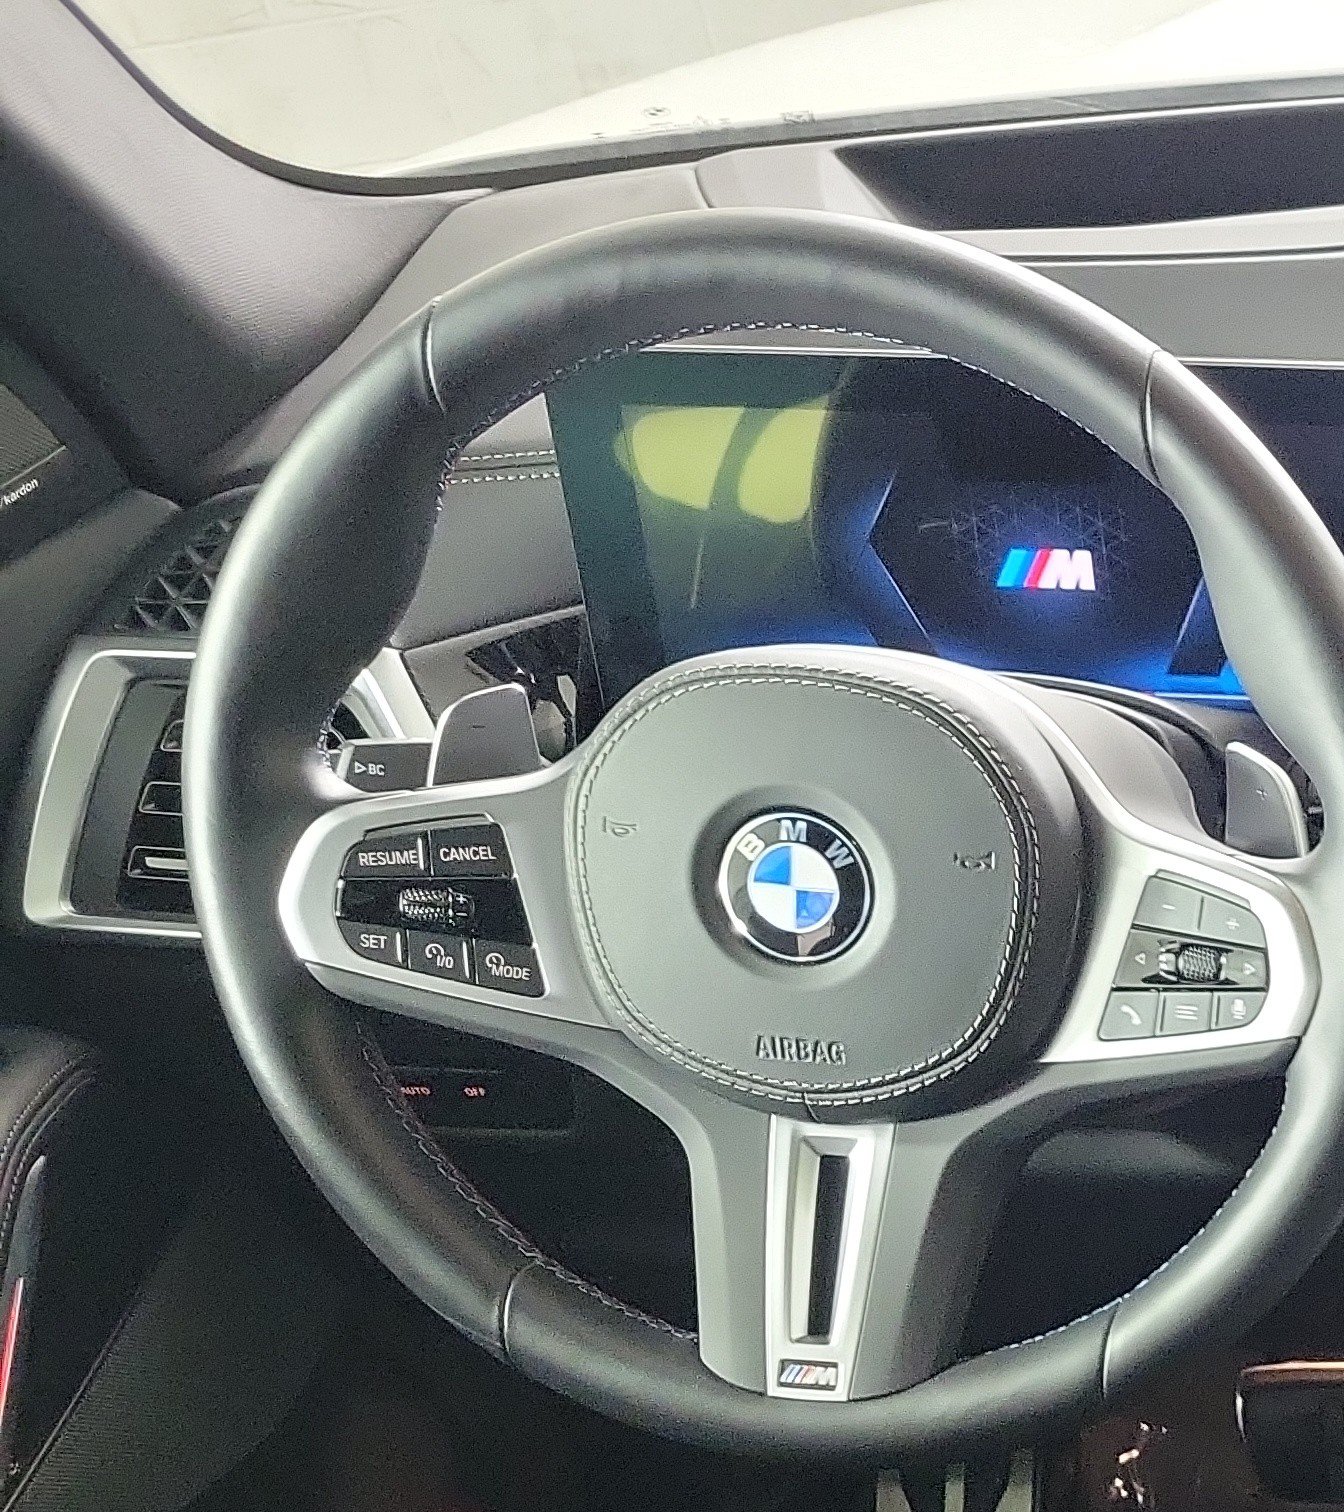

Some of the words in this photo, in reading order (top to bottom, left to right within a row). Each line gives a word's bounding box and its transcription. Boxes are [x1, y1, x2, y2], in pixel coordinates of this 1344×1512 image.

[368, 762, 385, 776] BC
[736, 818, 855, 871] BMW
[358, 849, 418, 867] RESUME
[439, 845, 497, 862] CANCEL
[359, 934, 388, 949] SET
[491, 963, 532, 981] MODE
[755, 1033, 847, 1066] AIRBAG
[400, 1086, 431, 1096] AUTO
